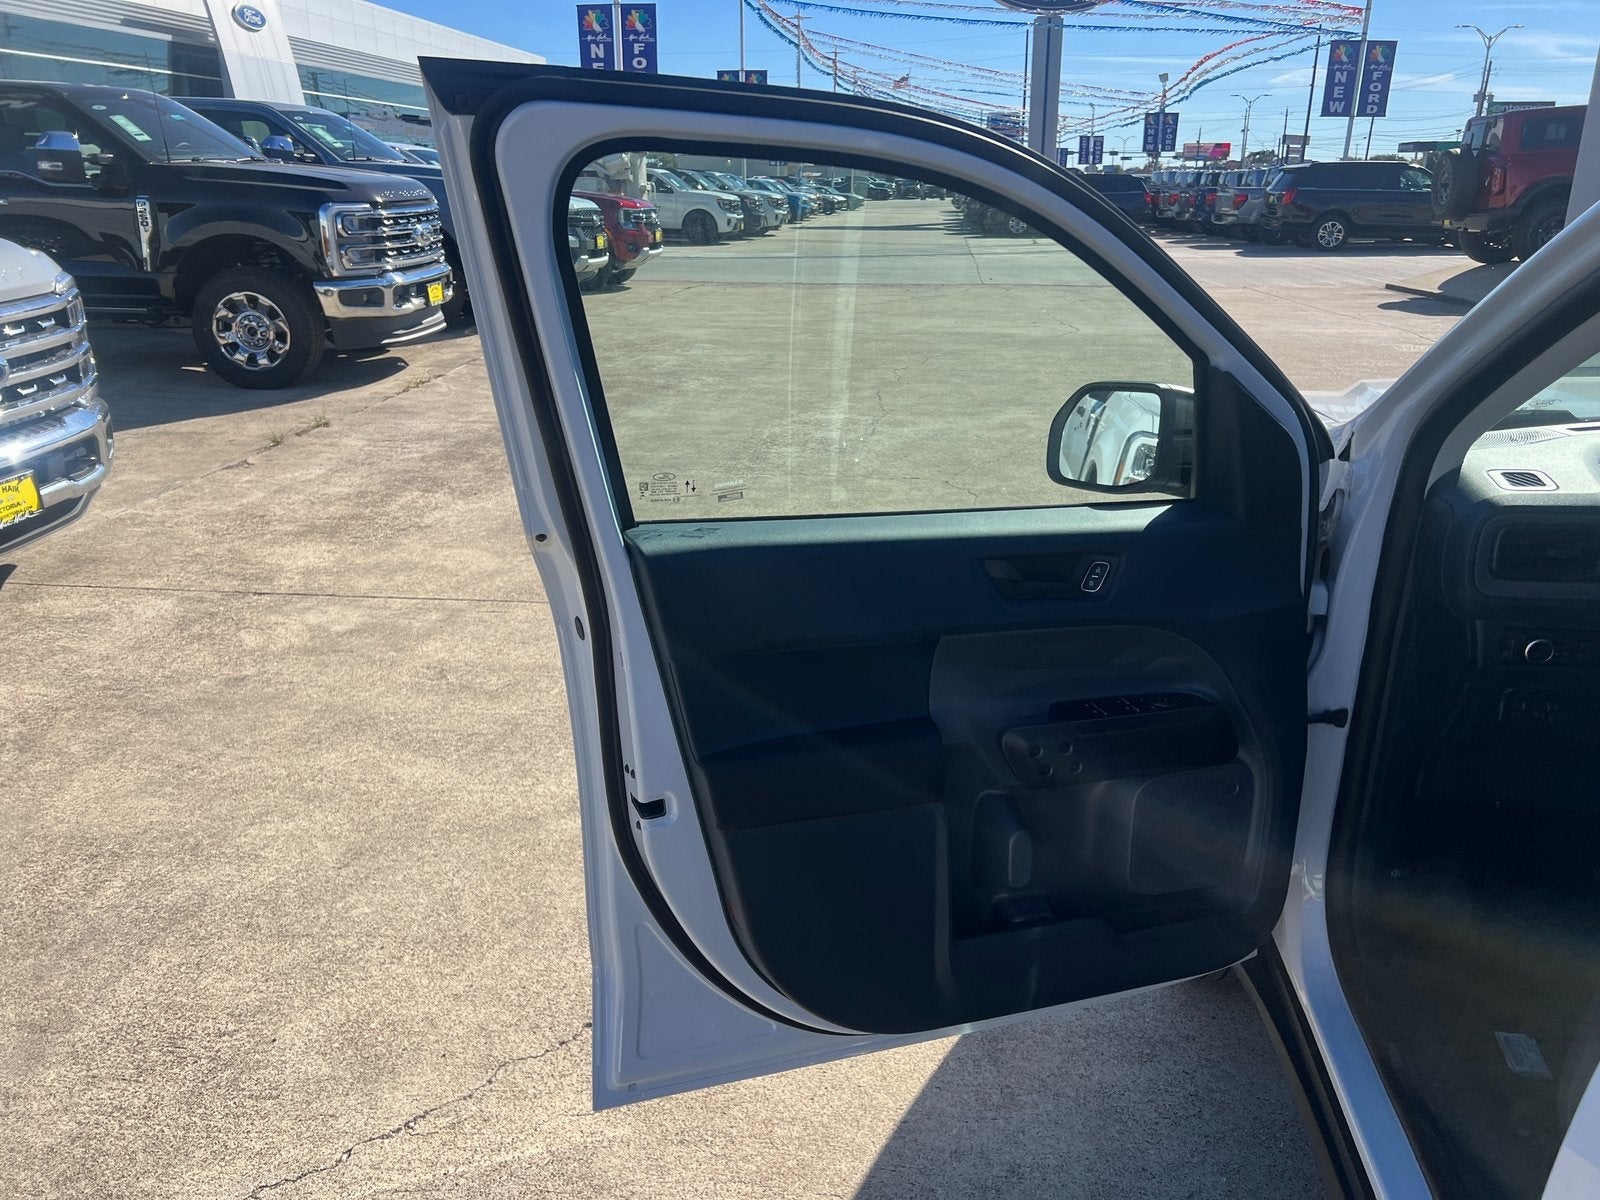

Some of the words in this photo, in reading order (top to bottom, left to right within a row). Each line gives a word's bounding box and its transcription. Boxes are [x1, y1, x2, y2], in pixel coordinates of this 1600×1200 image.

[1328, 71, 1347, 113] NEW
[1366, 71, 1383, 114] FORD
[1145, 128, 1155, 151] NEW
[1165, 128, 1173, 150] FORD
